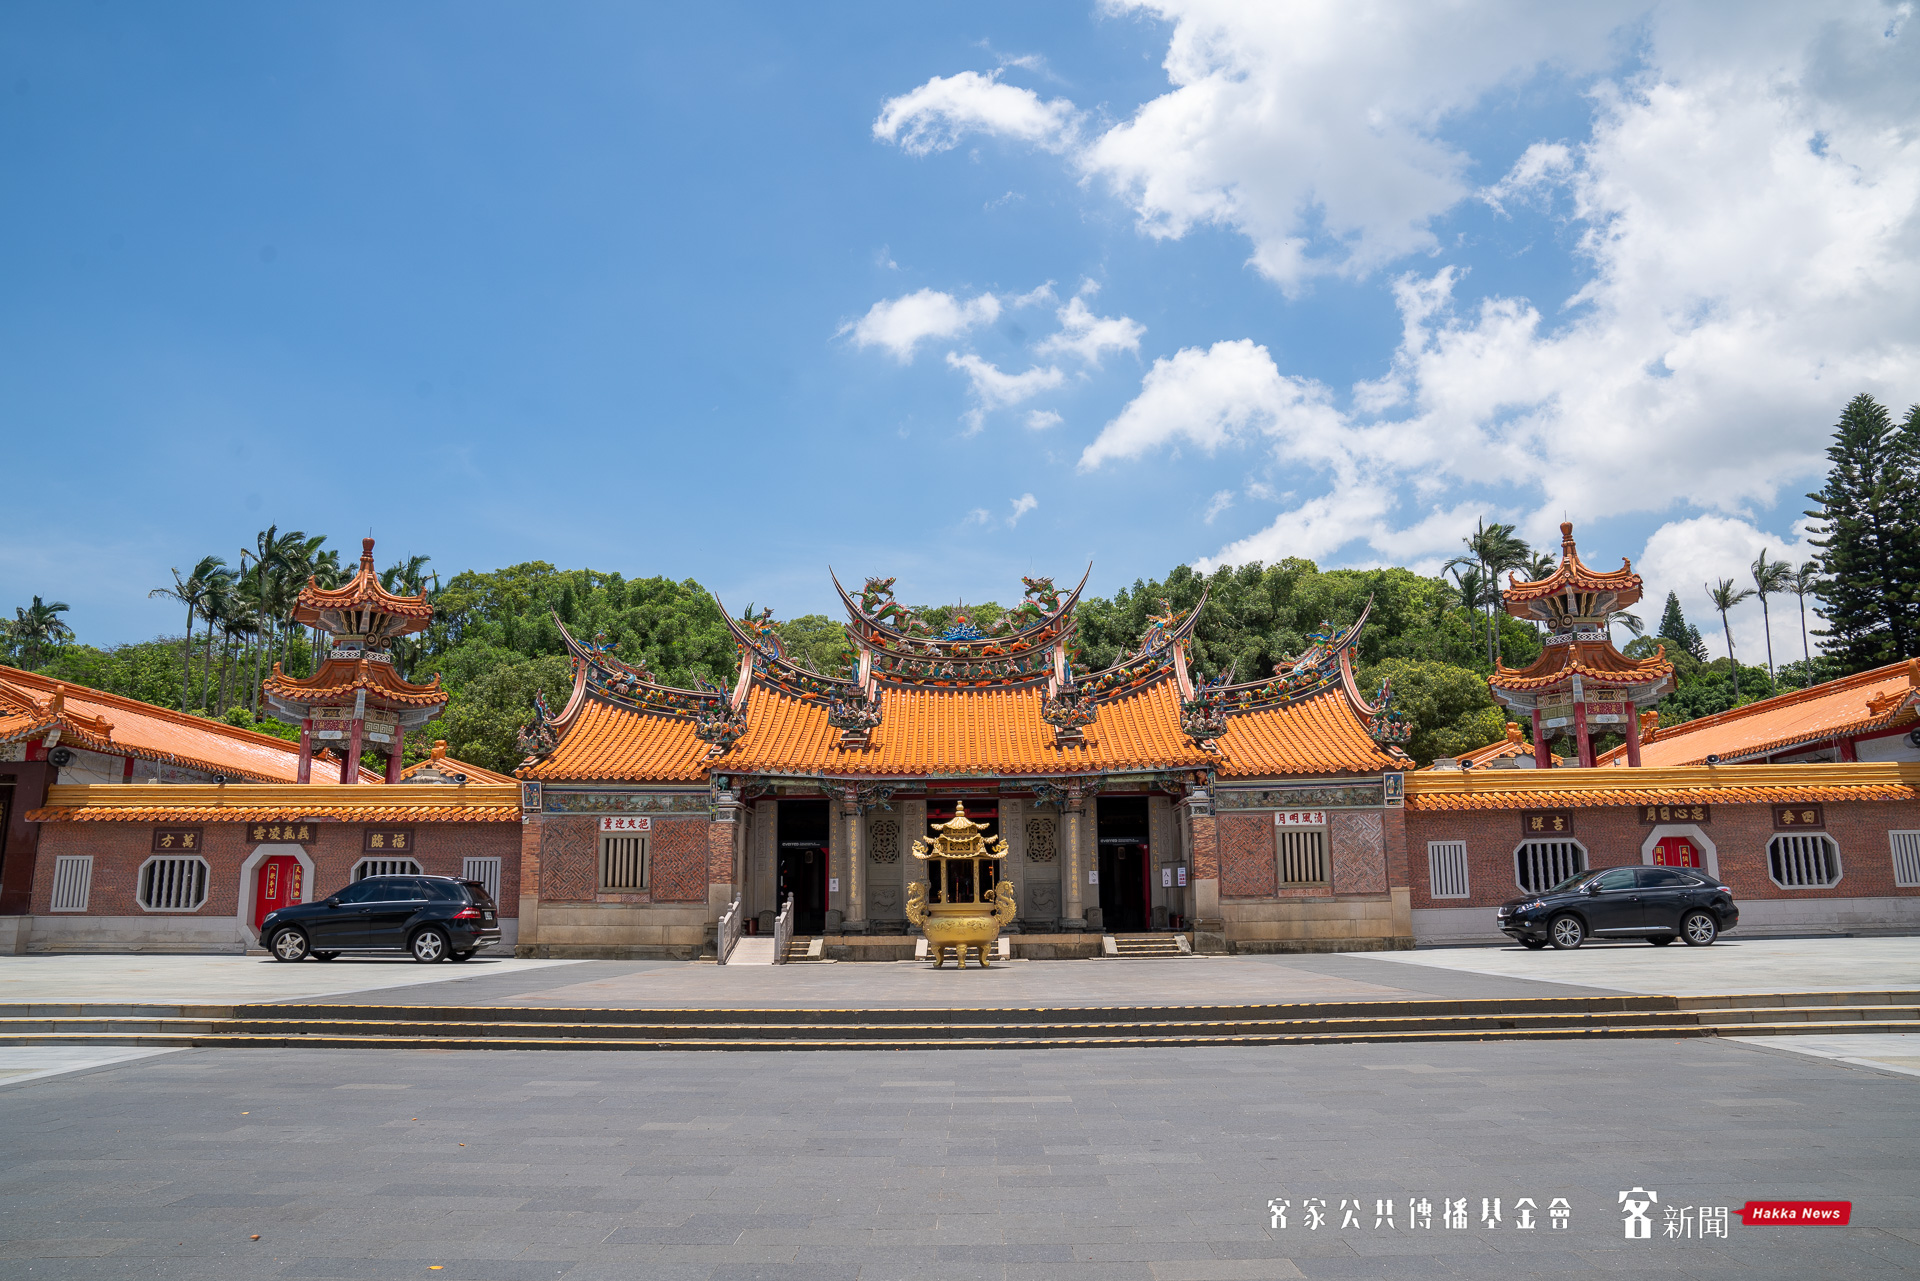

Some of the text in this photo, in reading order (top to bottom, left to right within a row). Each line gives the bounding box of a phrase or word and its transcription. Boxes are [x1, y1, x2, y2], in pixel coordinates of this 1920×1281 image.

[1278, 811, 1324, 824] 清風明月
[1646, 805, 1704, 821] 忠心日月
[1782, 809, 1815, 825] 四季
[1531, 815, 1564, 831] 吉祥
[161, 833, 195, 848] 萬方
[371, 833, 405, 848] 福臨
